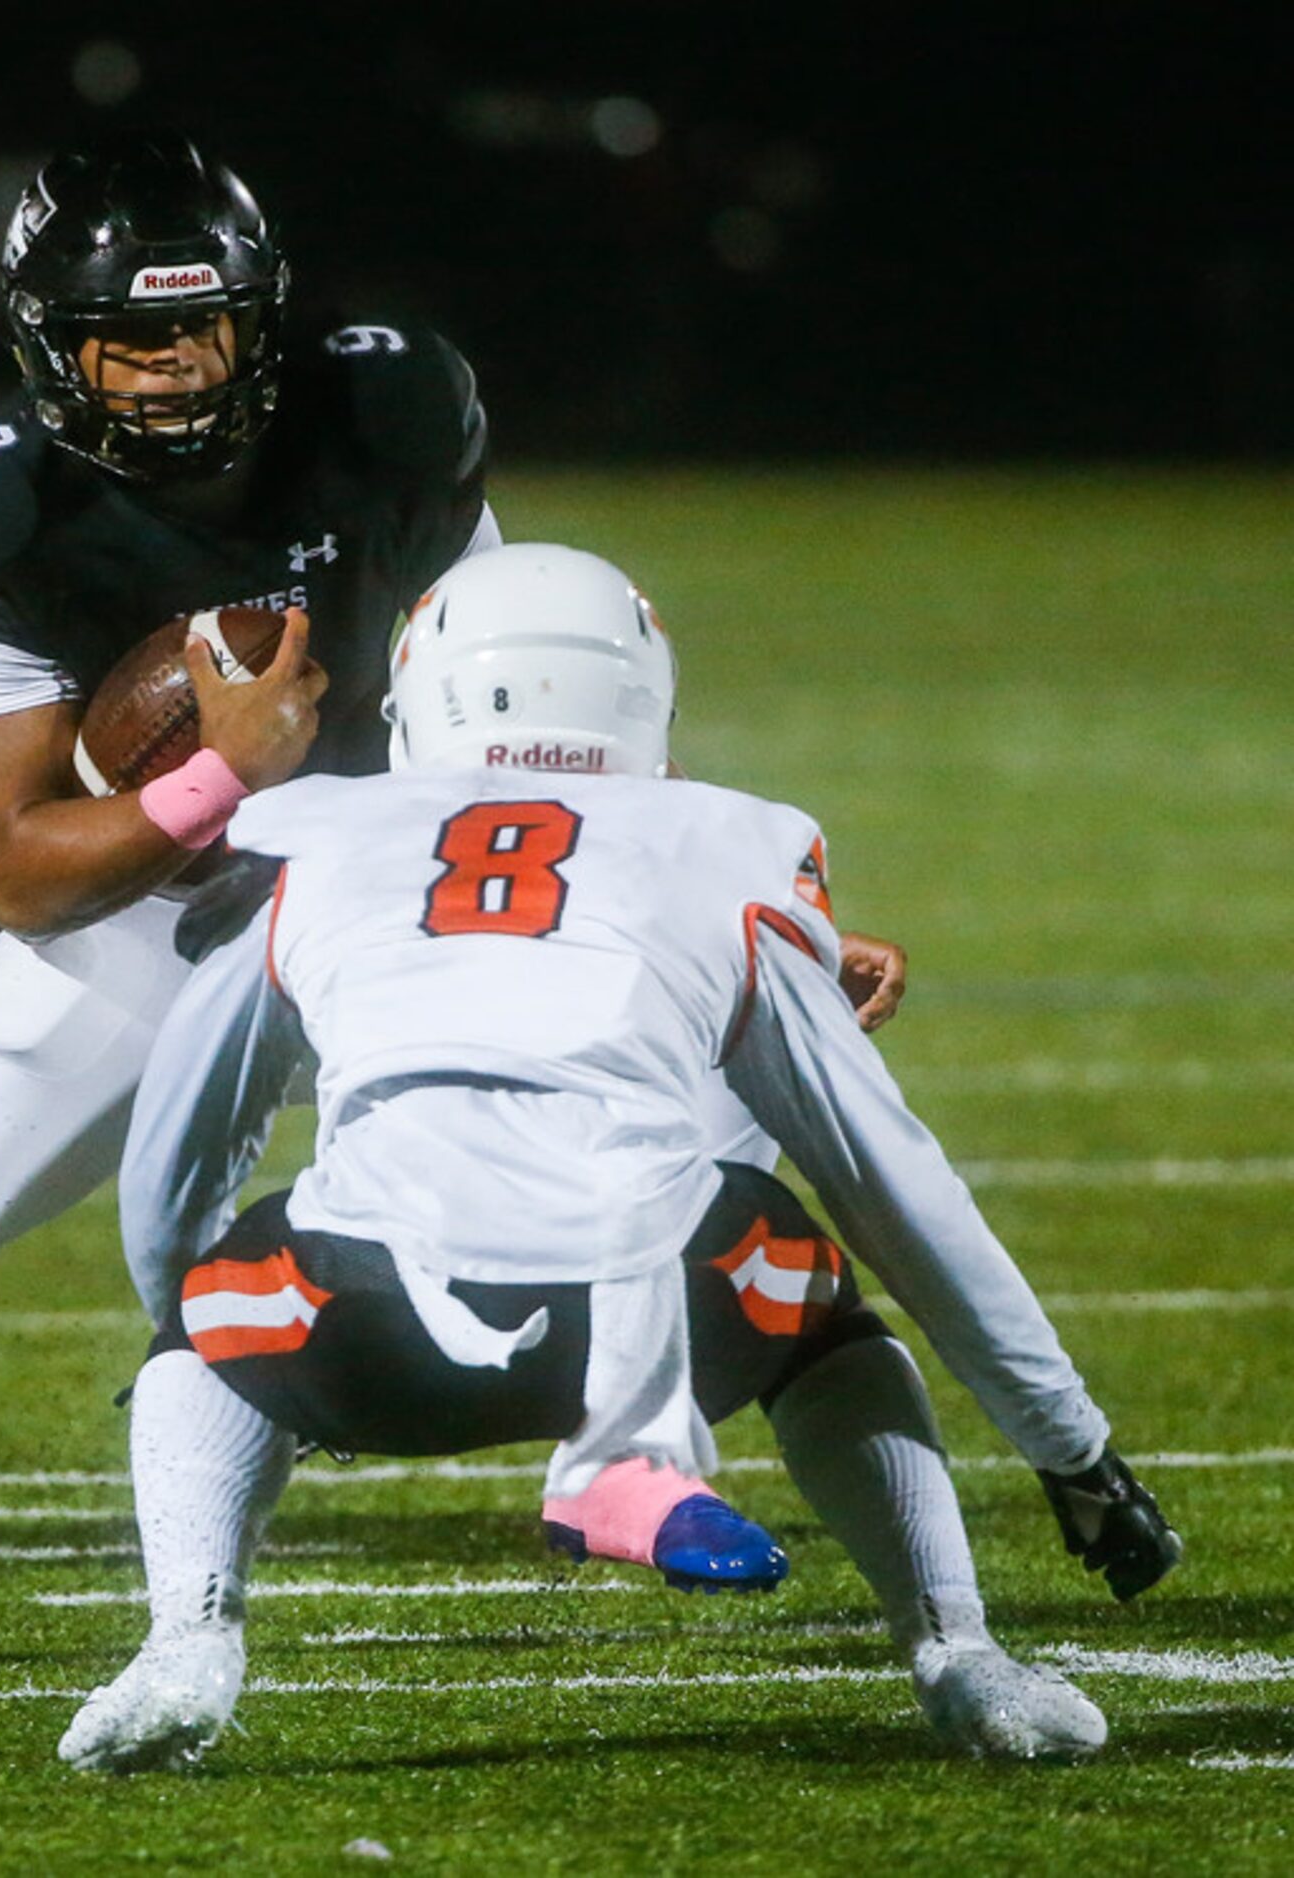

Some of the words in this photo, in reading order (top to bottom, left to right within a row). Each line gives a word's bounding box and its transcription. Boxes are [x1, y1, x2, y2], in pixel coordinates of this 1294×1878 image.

[143, 269, 213, 289] Riddell
[493, 686, 509, 712] 8
[485, 743, 605, 768] Riddell
[416, 798, 585, 939] 8
